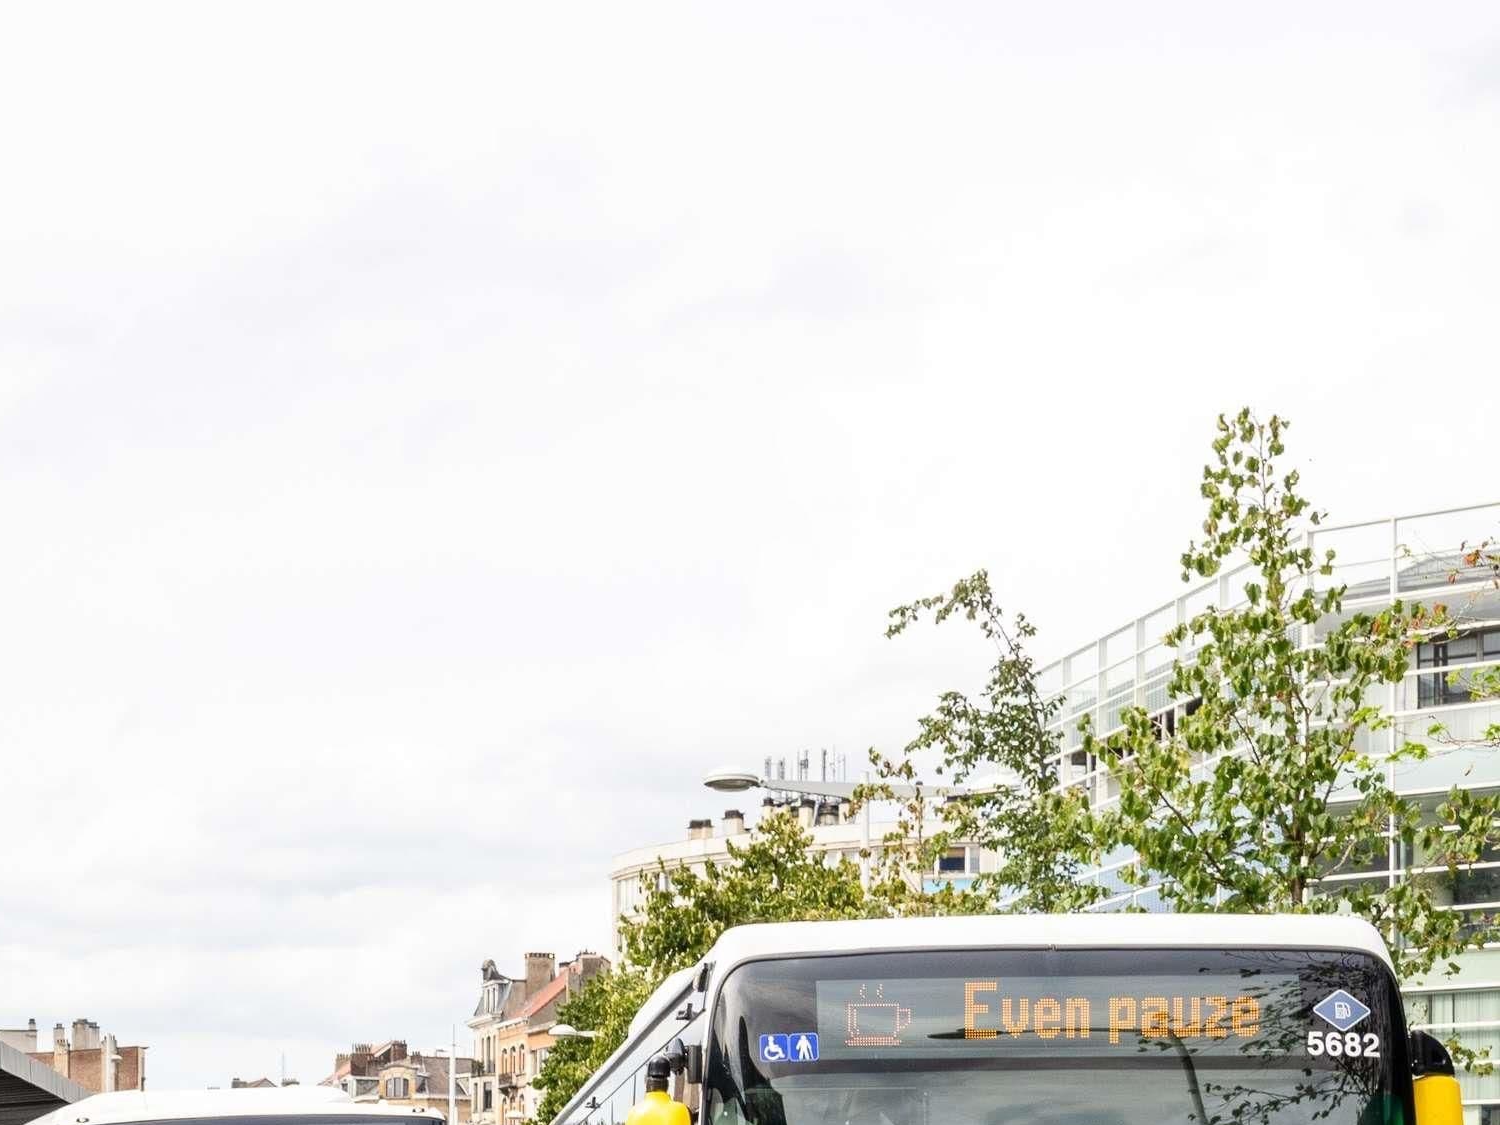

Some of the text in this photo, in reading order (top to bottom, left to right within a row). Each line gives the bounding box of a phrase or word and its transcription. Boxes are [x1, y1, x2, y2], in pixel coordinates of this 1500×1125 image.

[963, 981, 1261, 1046] Even pauze
[1306, 1030, 1381, 1058] 5682
